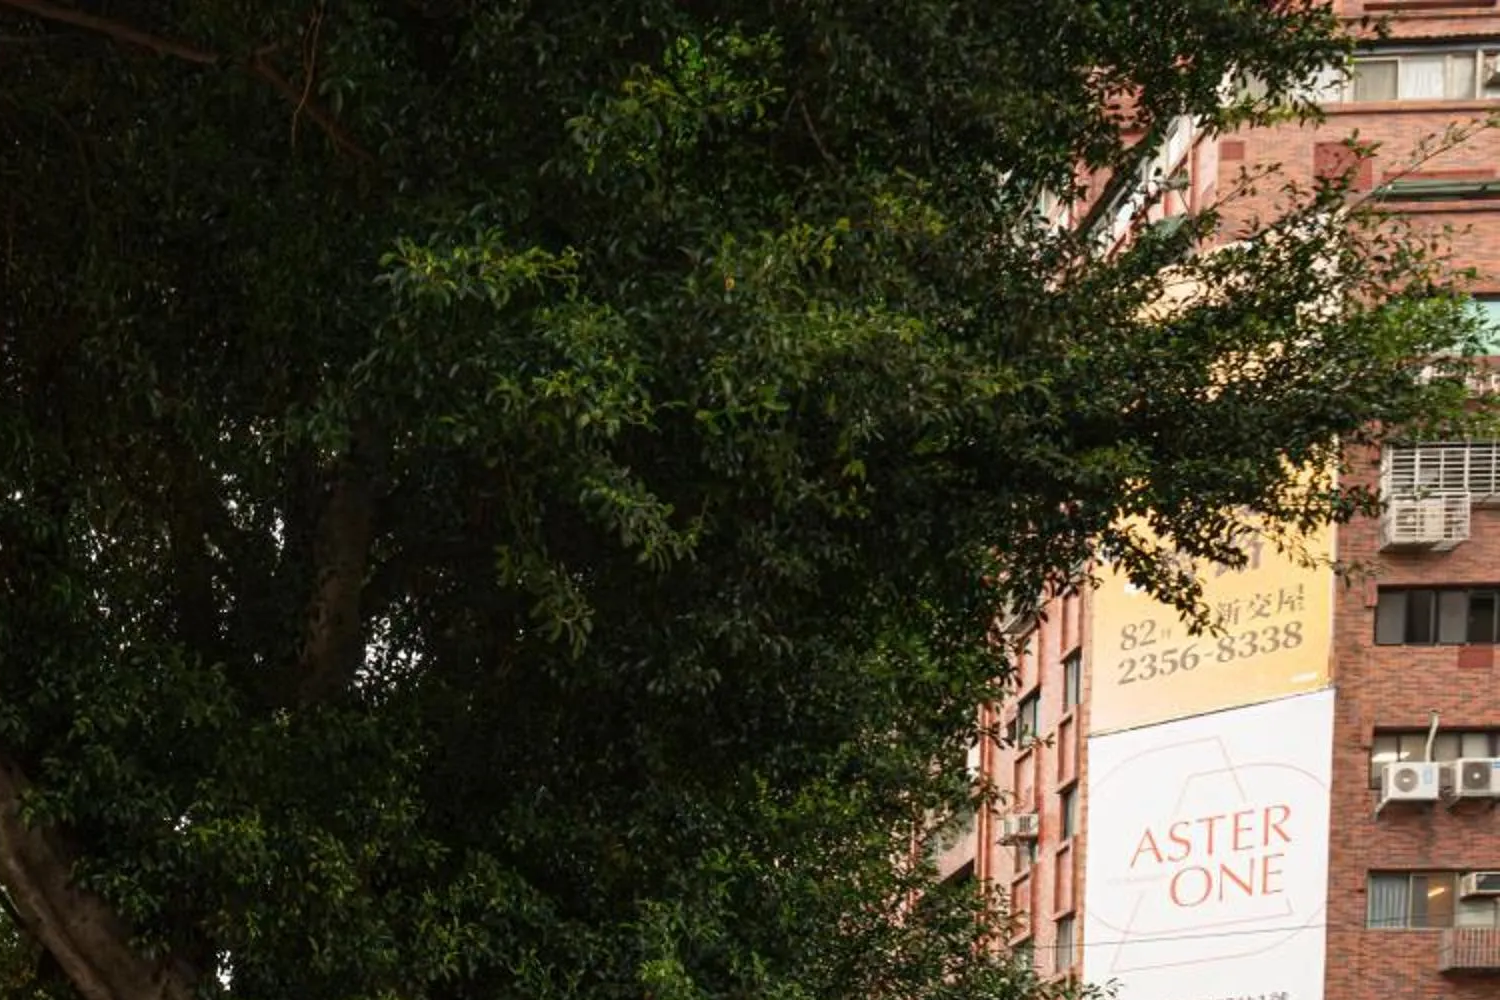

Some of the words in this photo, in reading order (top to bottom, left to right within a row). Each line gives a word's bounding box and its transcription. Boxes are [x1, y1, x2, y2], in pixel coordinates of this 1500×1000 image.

[1117, 621, 1304, 686] 2356-8338
[1120, 619, 1157, 652] 82
[1129, 804, 1293, 869] ASTER
[1169, 853, 1285, 908] ONE
